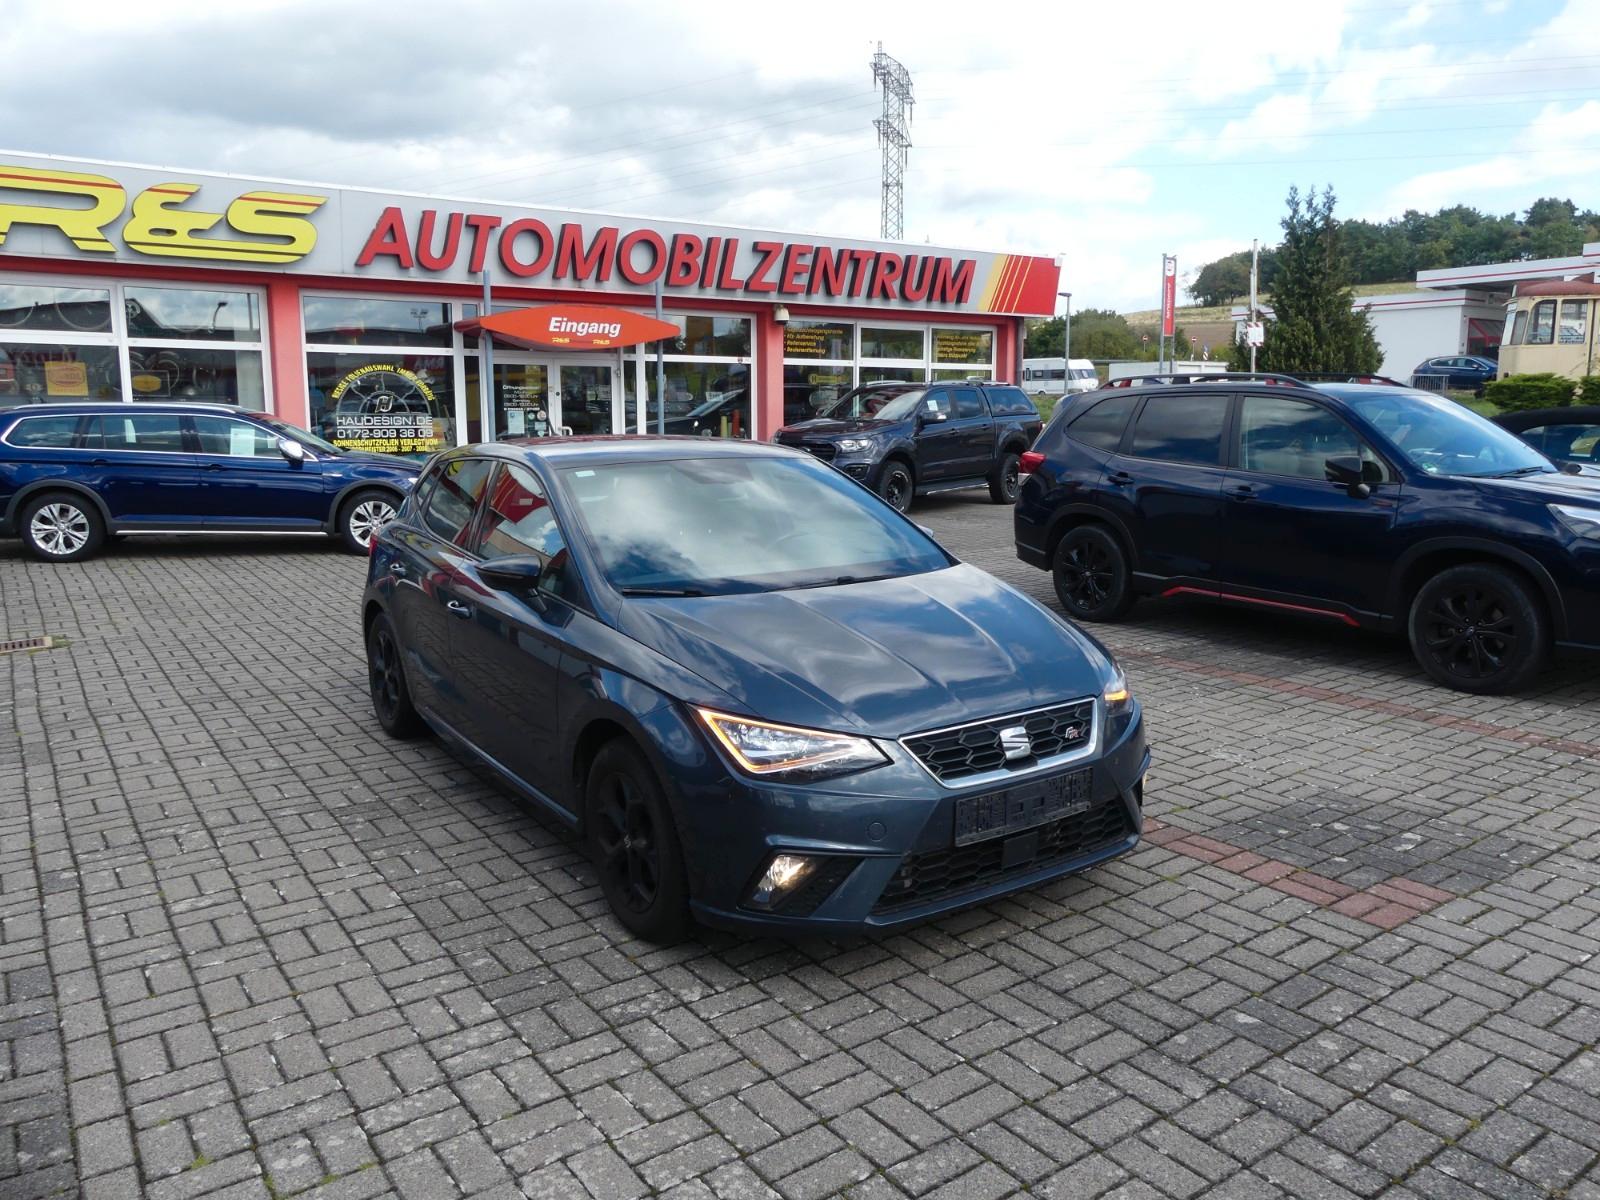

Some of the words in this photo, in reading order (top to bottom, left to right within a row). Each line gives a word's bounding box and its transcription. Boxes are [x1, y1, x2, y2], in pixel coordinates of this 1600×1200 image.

[0, 165, 329, 264] R&S
[356, 206, 976, 305] AUTOMOBILZENTRUM
[549, 316, 621, 338] Eingang
[336, 416, 433, 426] HAUDESIGN.DE
[399, 428, 416, 438] 36
